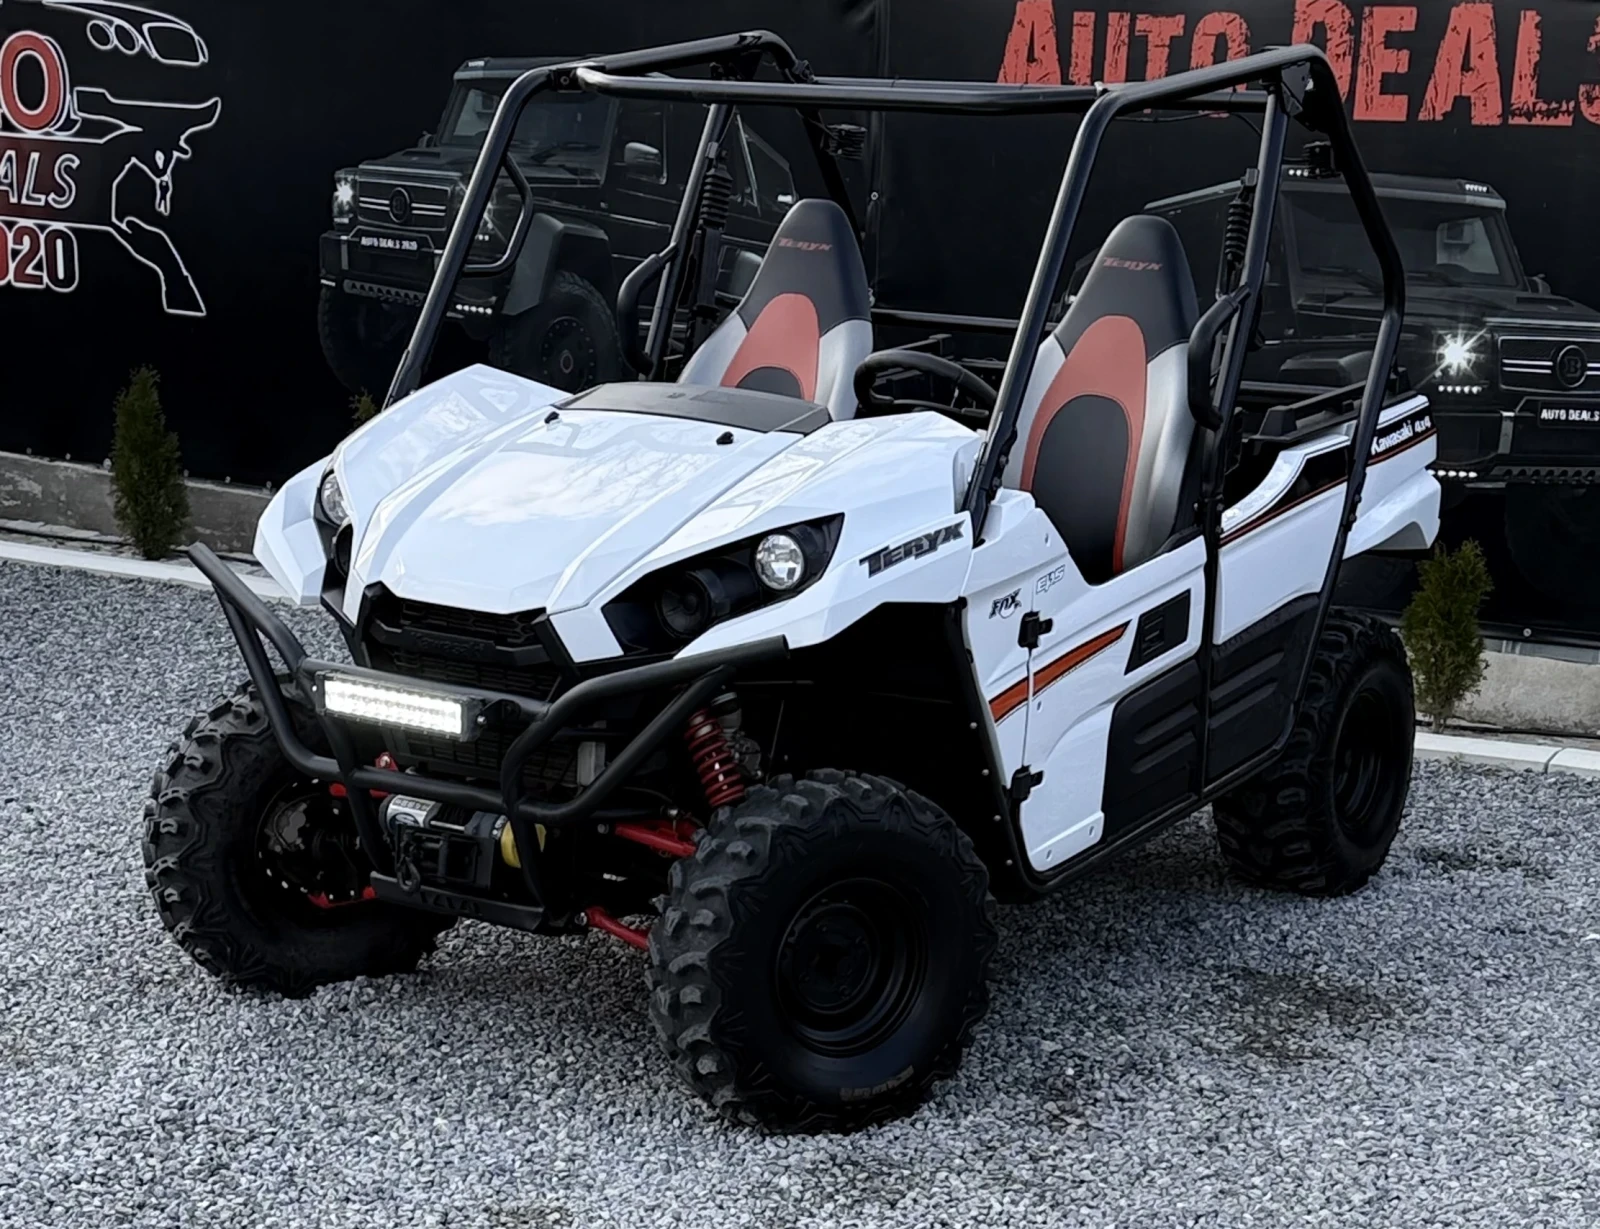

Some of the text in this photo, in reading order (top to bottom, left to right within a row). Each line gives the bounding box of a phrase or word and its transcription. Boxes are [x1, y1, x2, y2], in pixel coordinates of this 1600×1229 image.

[997, 0, 1251, 118] AUTO
[1540, 408, 1566, 421] AUTO
[1371, 419, 1413, 456] Kawasaki
[988, 587, 1023, 619] FOX
